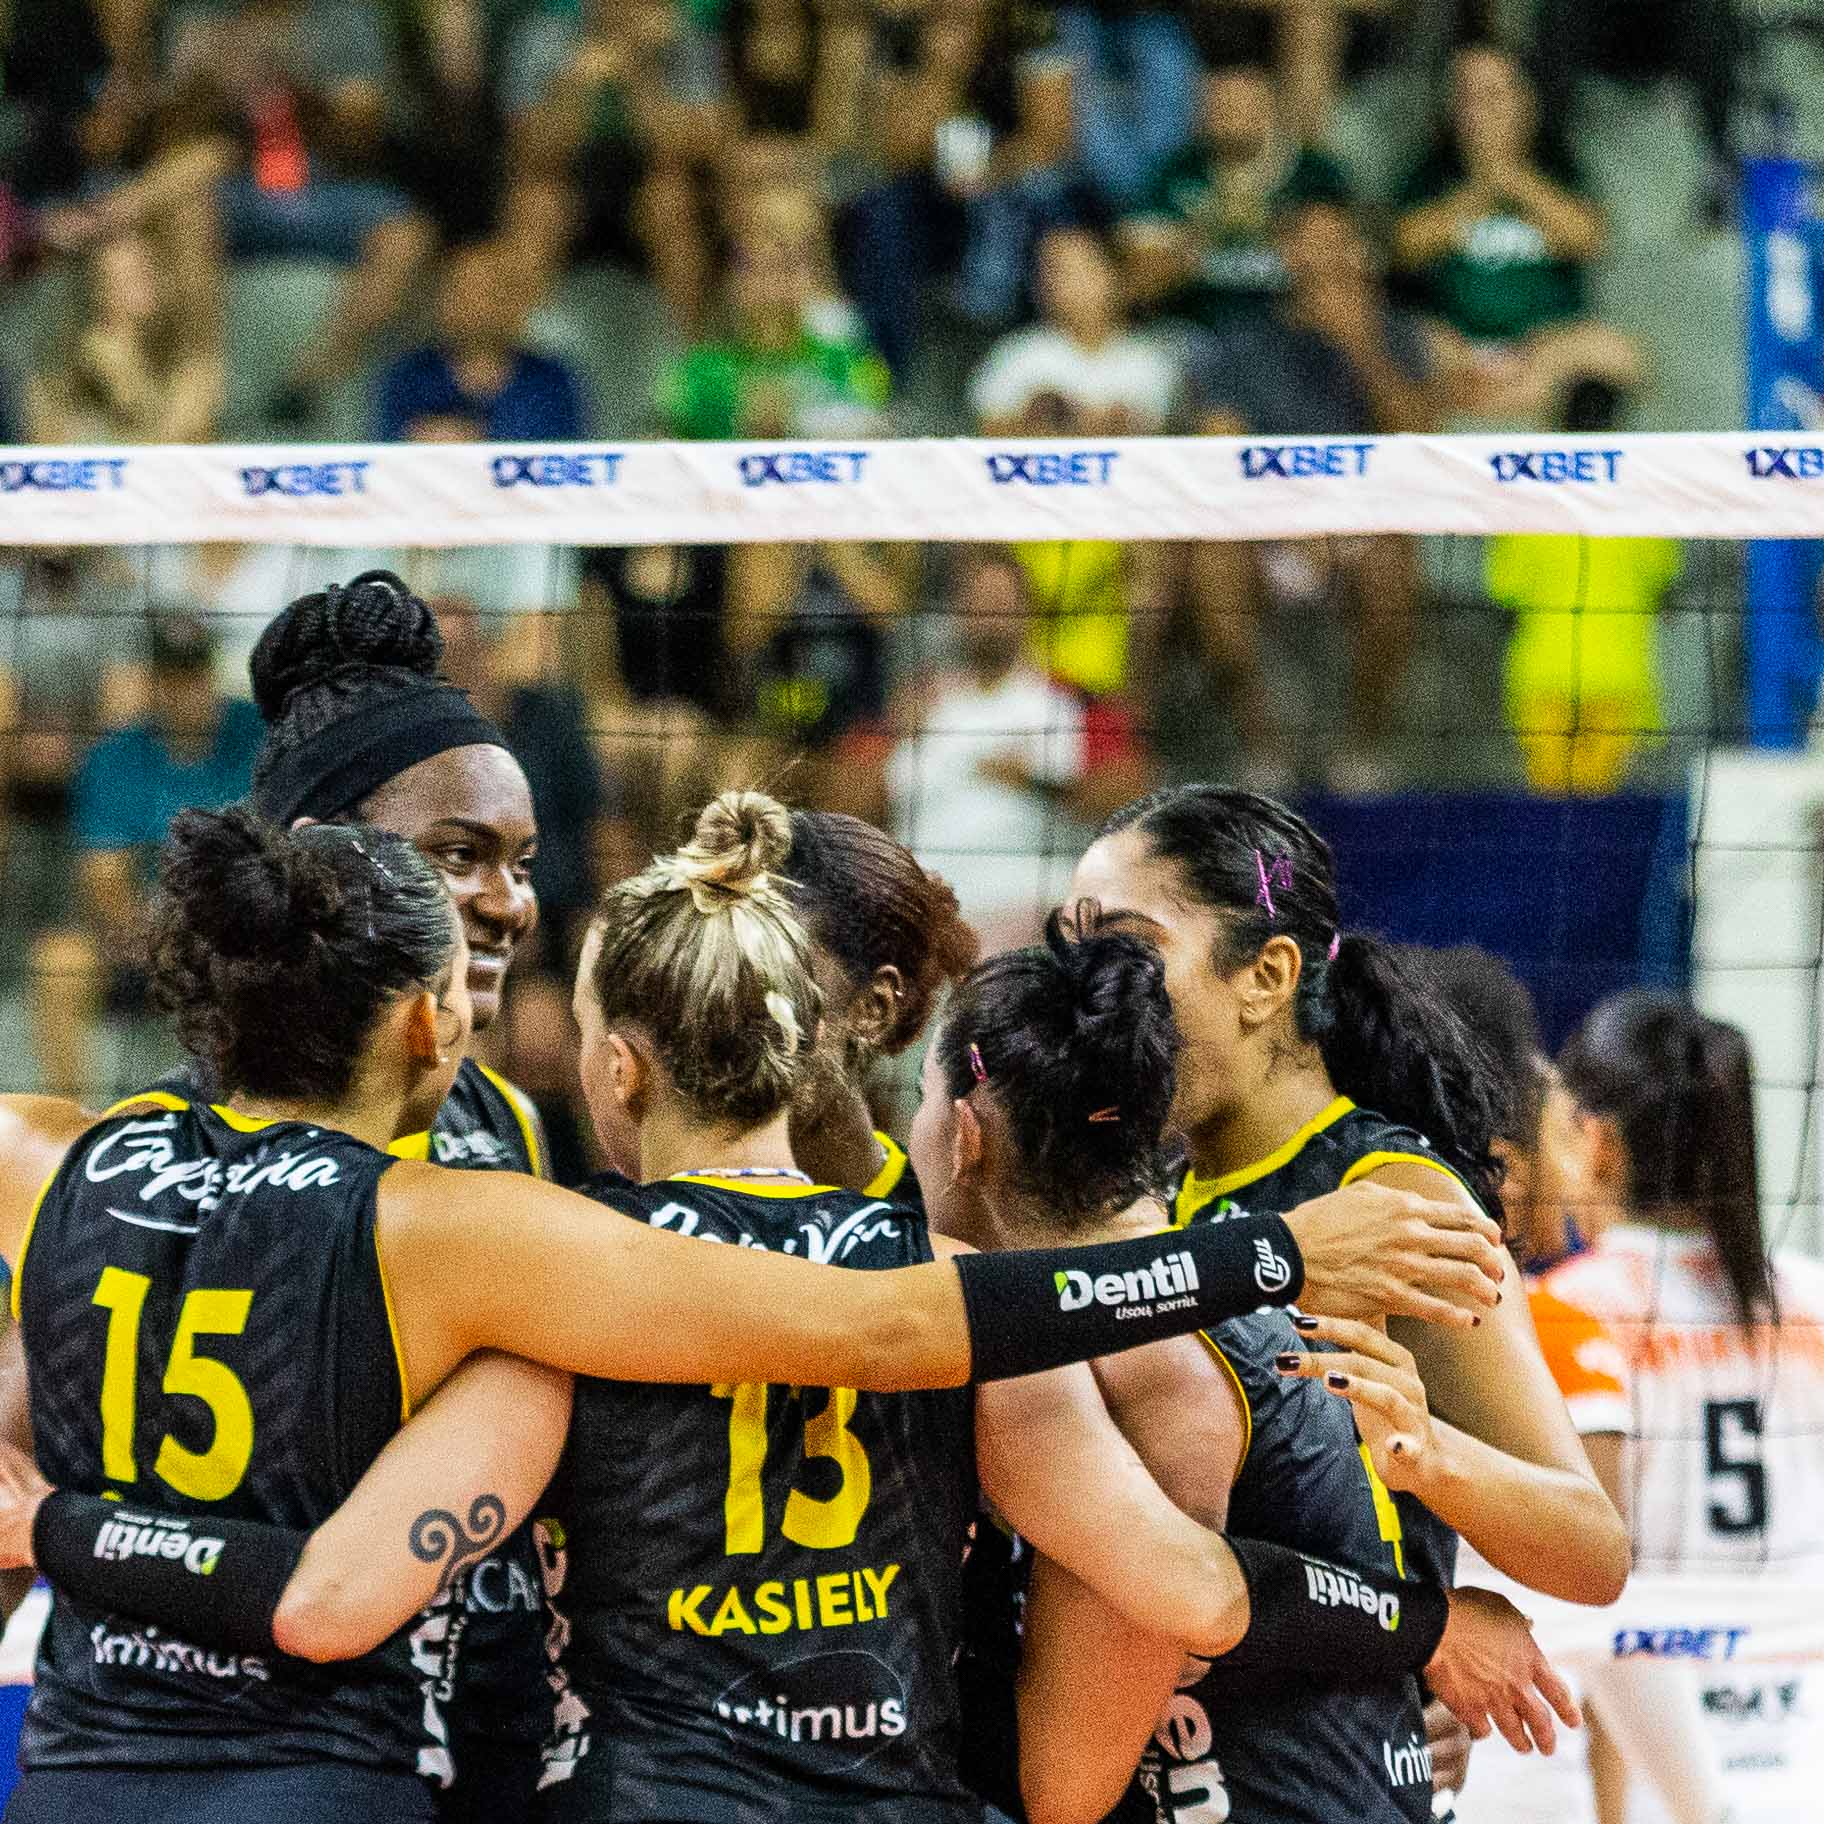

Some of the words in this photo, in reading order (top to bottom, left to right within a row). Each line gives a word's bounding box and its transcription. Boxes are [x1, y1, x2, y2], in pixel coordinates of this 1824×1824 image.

[239, 459, 372, 498] 1XBET
[487, 452, 626, 488] 1XBET
[736, 450, 872, 488] 1XBET
[983, 450, 1121, 487] 1XBET
[1237, 442, 1378, 480] 1XBET
[1487, 448, 1626, 485] 1XBET
[1053, 1251, 1201, 1312] Dentil
[92, 1266, 255, 1501] 15
[710, 1382, 873, 1556] 13
[1702, 1397, 1769, 1538] 5
[93, 1519, 227, 1577] Dentil
[667, 1563, 901, 1637] KASIELY
[1303, 1563, 1401, 1632] Dentil
[1612, 1626, 1747, 1660] 1XBET
